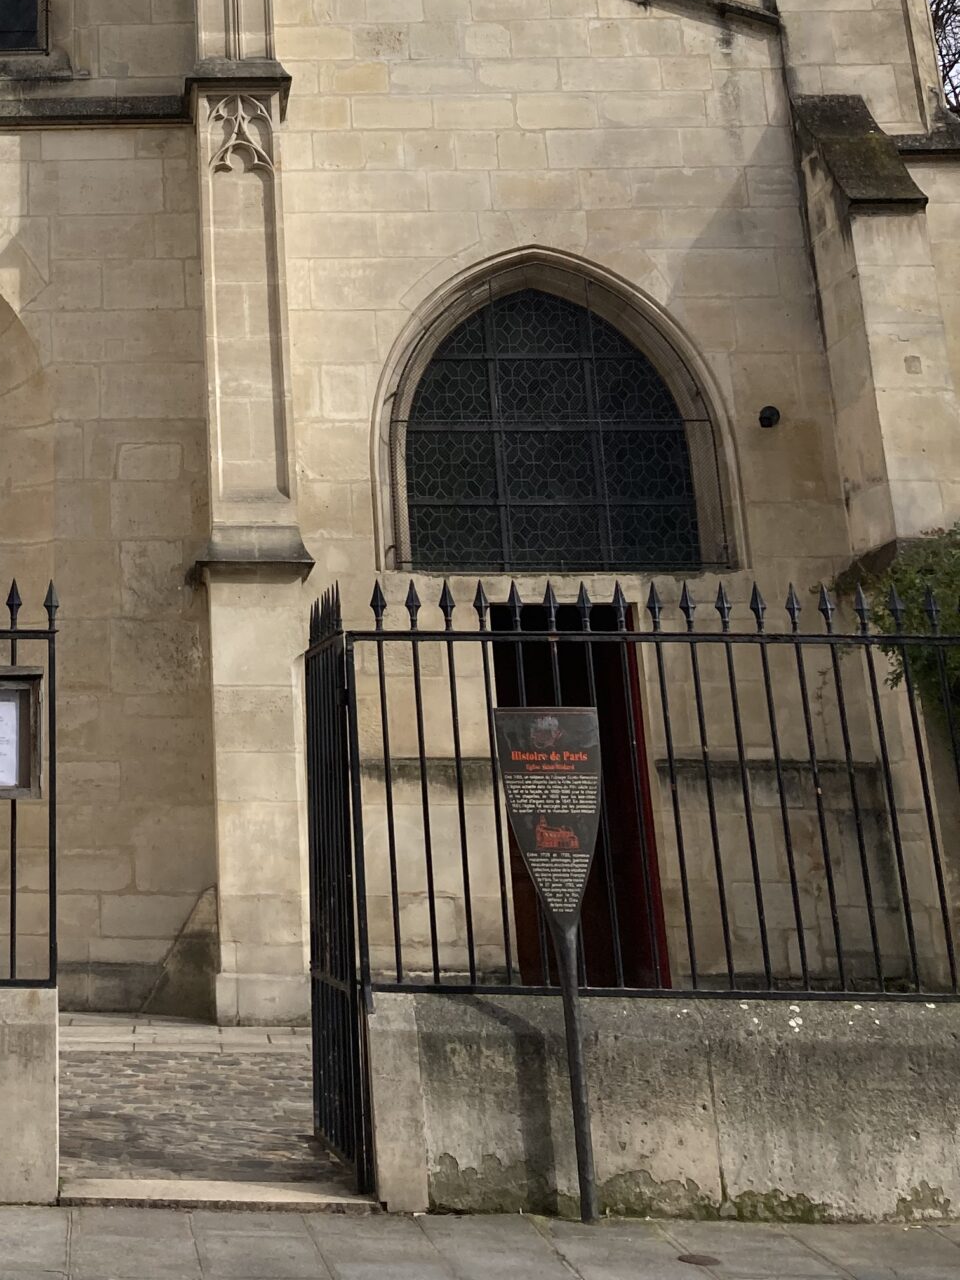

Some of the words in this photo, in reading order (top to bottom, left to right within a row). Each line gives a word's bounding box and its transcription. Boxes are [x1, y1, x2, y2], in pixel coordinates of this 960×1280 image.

[511, 751, 547, 761] Histoire
[550, 751, 560, 761] de
[563, 751, 588, 761] Paris
